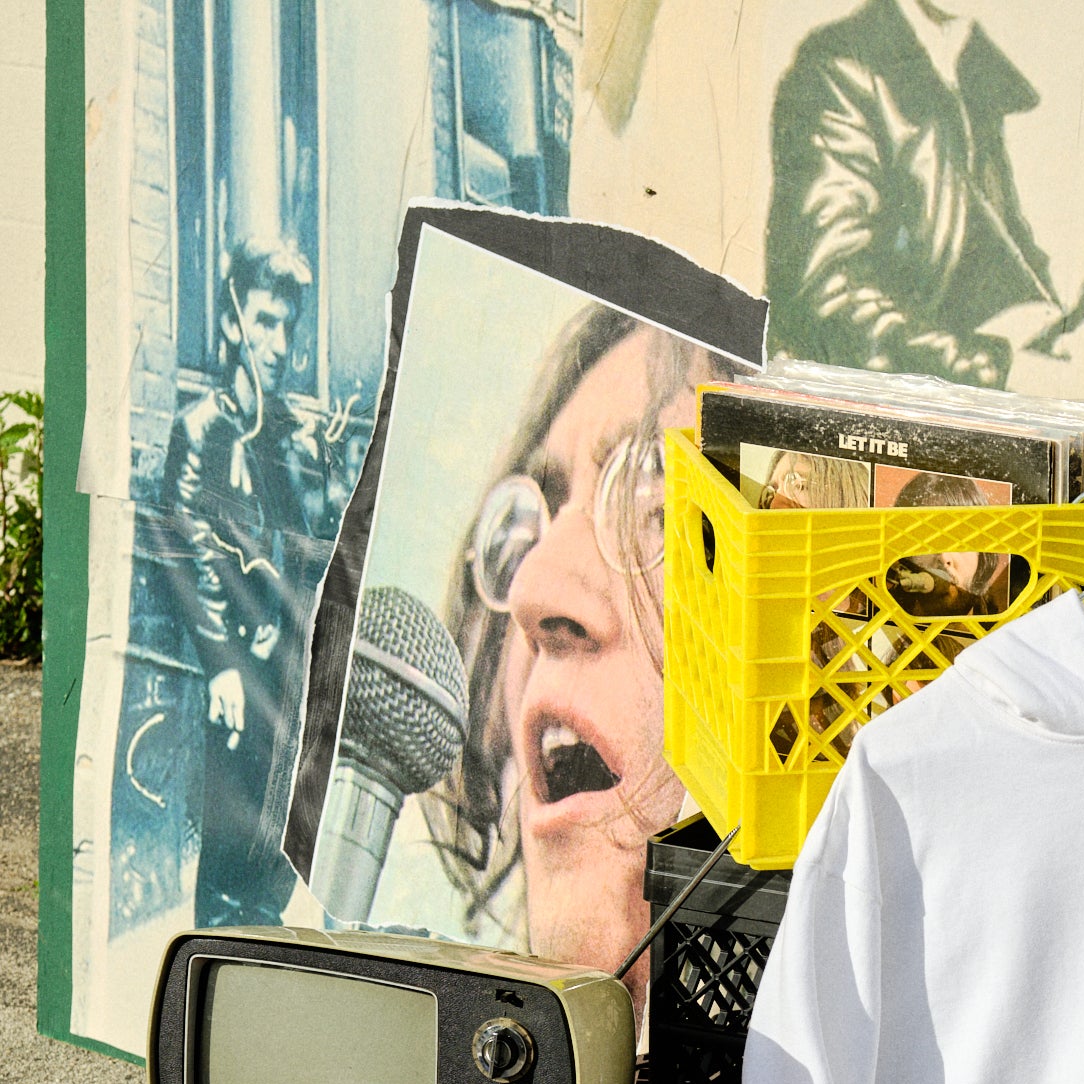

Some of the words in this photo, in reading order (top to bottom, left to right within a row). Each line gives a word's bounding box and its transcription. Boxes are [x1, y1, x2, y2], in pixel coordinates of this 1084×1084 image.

[838, 433, 868, 452] LET
[869, 438, 886, 454] IT
[887, 440, 908, 458] BE
